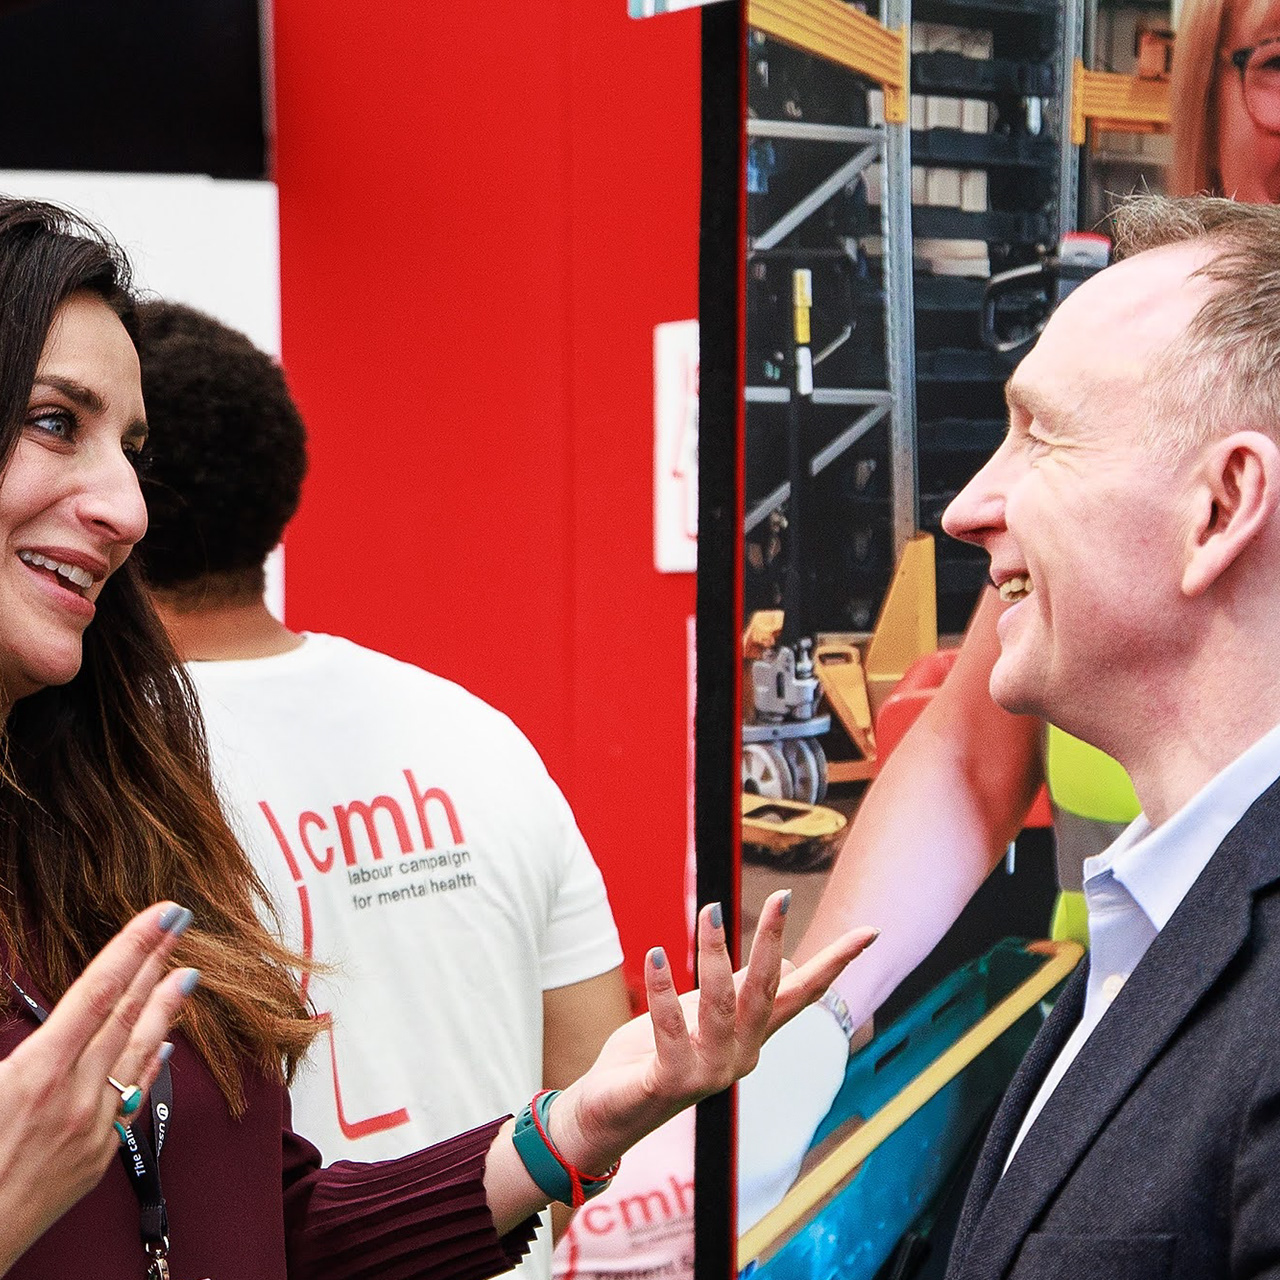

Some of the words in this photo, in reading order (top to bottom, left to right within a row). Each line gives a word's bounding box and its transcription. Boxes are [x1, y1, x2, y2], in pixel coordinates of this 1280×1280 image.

[348, 866, 393, 886] labour
[398, 850, 471, 875] campaign
[352, 895, 372, 911] for
[378, 880, 429, 906] mental
[430, 872, 477, 894] health
[132, 1153, 146, 1177] The
